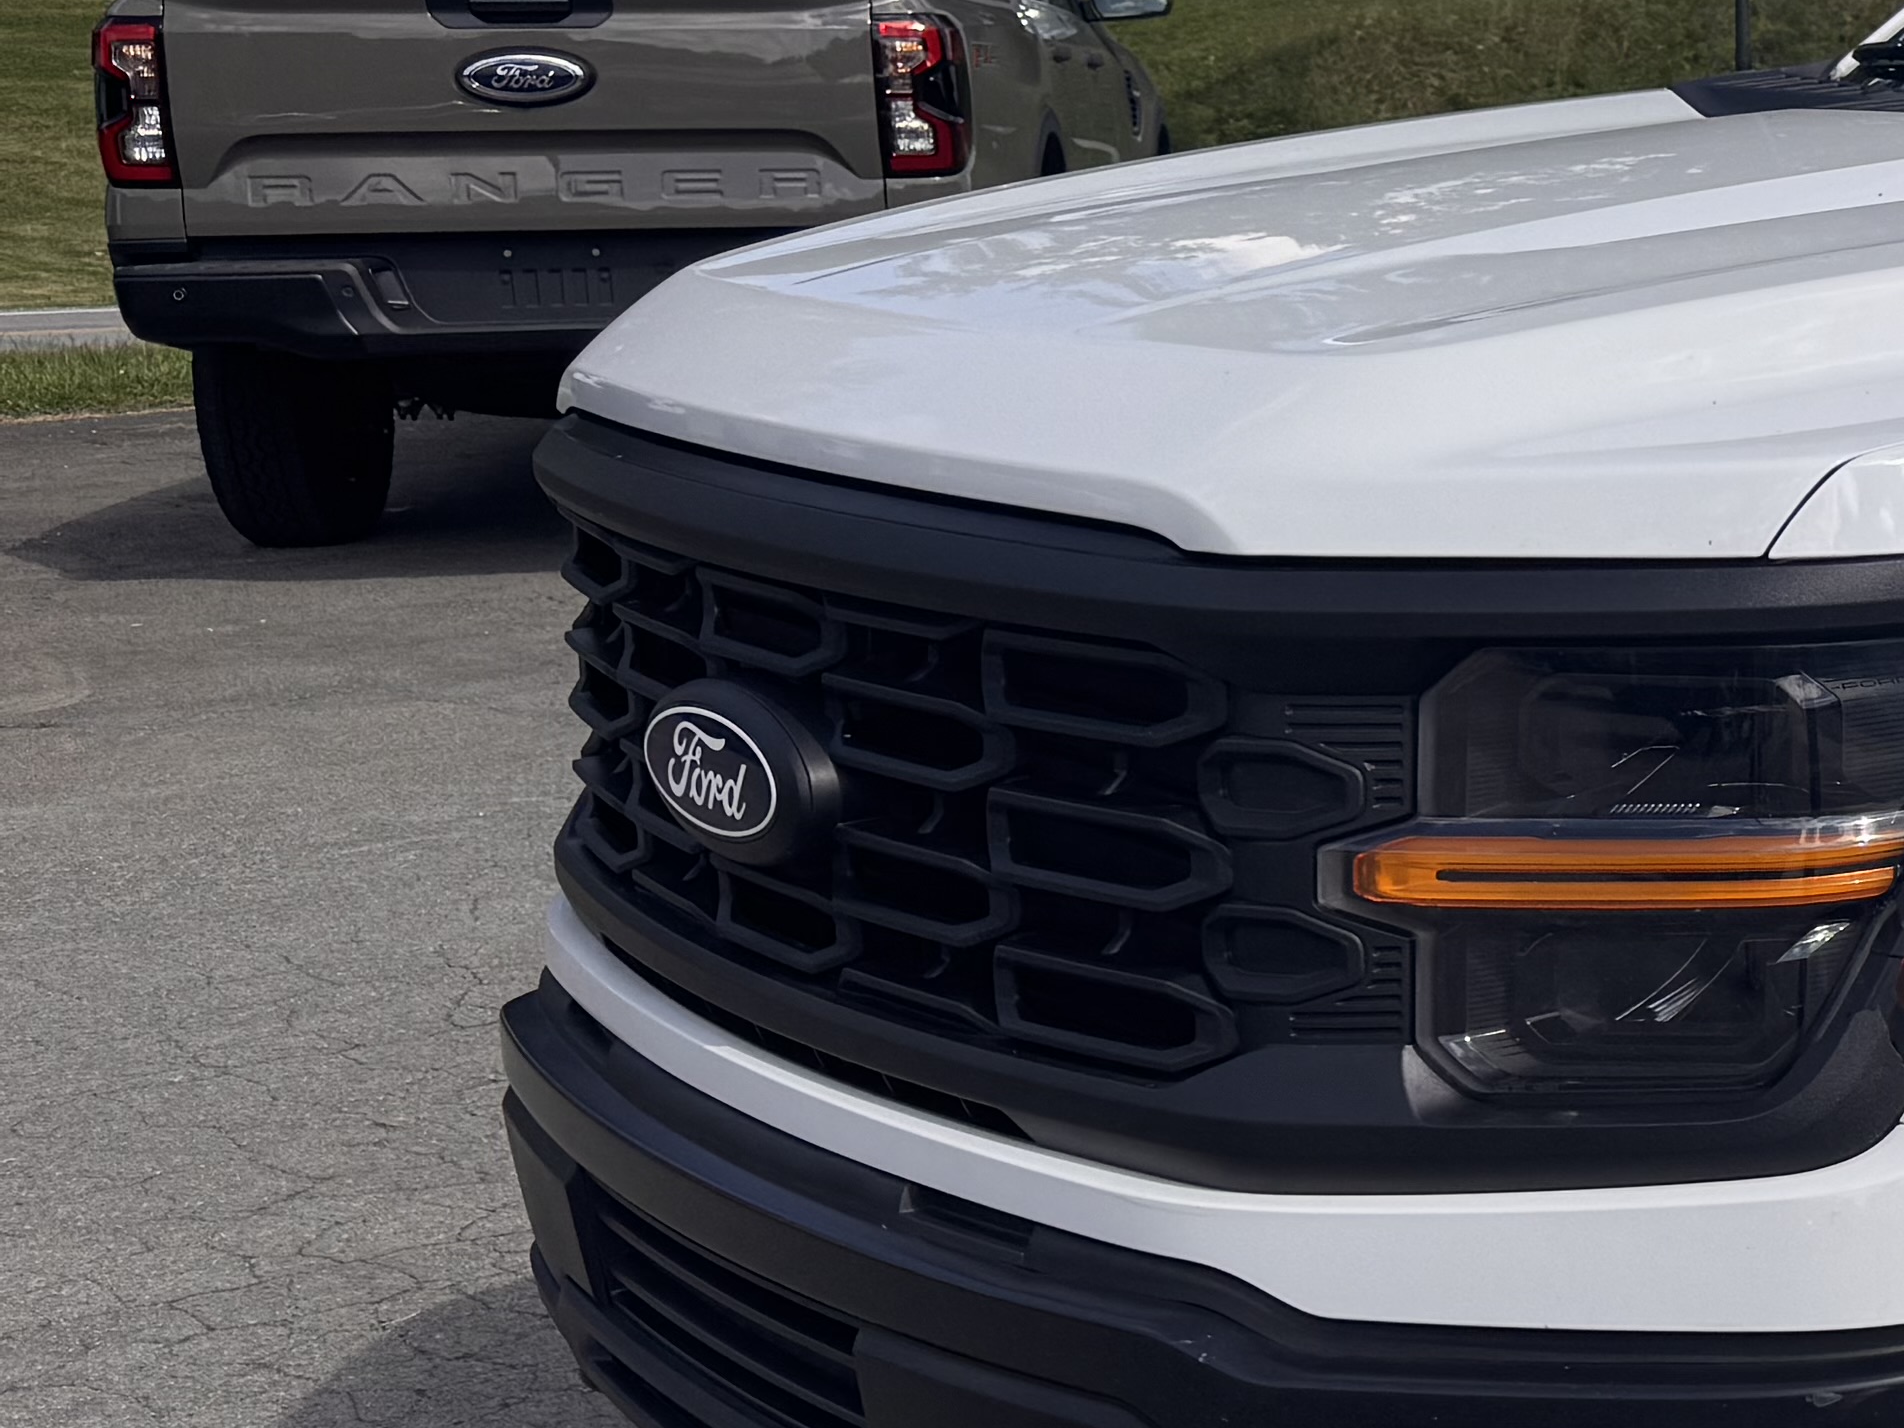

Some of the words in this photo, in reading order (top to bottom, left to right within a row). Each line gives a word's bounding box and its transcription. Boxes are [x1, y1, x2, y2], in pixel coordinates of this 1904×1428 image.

[491, 64, 555, 89] Ford
[246, 169, 822, 208] RANGER
[668, 721, 747, 820] Ford
